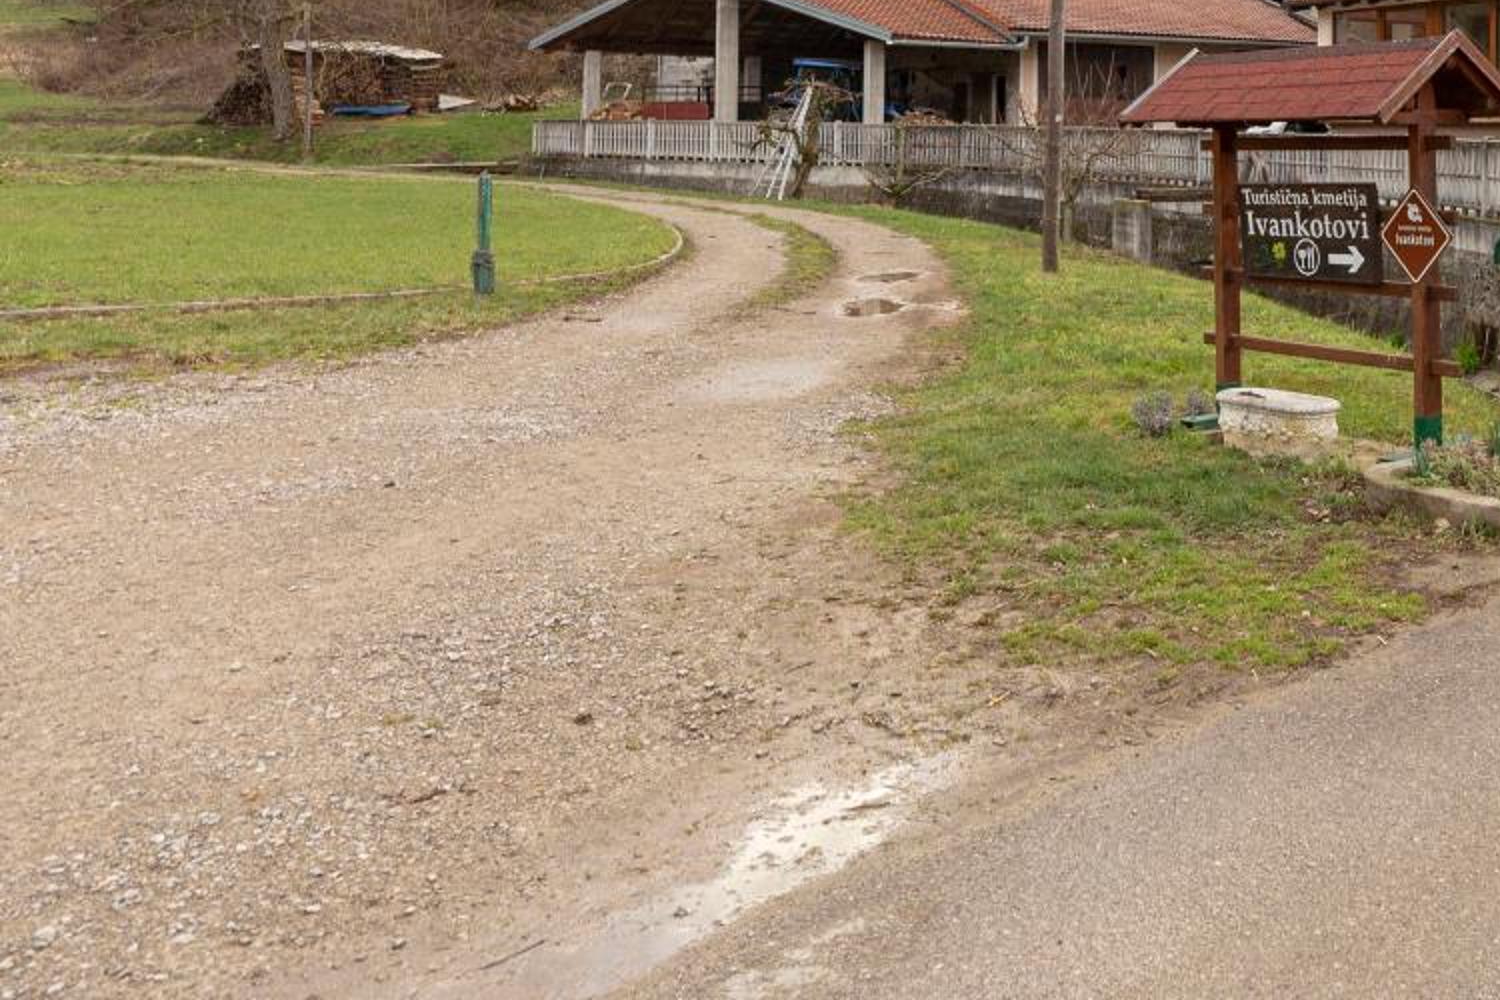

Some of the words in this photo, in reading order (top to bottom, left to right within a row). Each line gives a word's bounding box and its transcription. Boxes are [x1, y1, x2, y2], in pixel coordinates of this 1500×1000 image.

[1241, 188, 1308, 205] Turistična
[1311, 187, 1367, 211] kmetija
[1246, 210, 1369, 239] Ivankotovi
